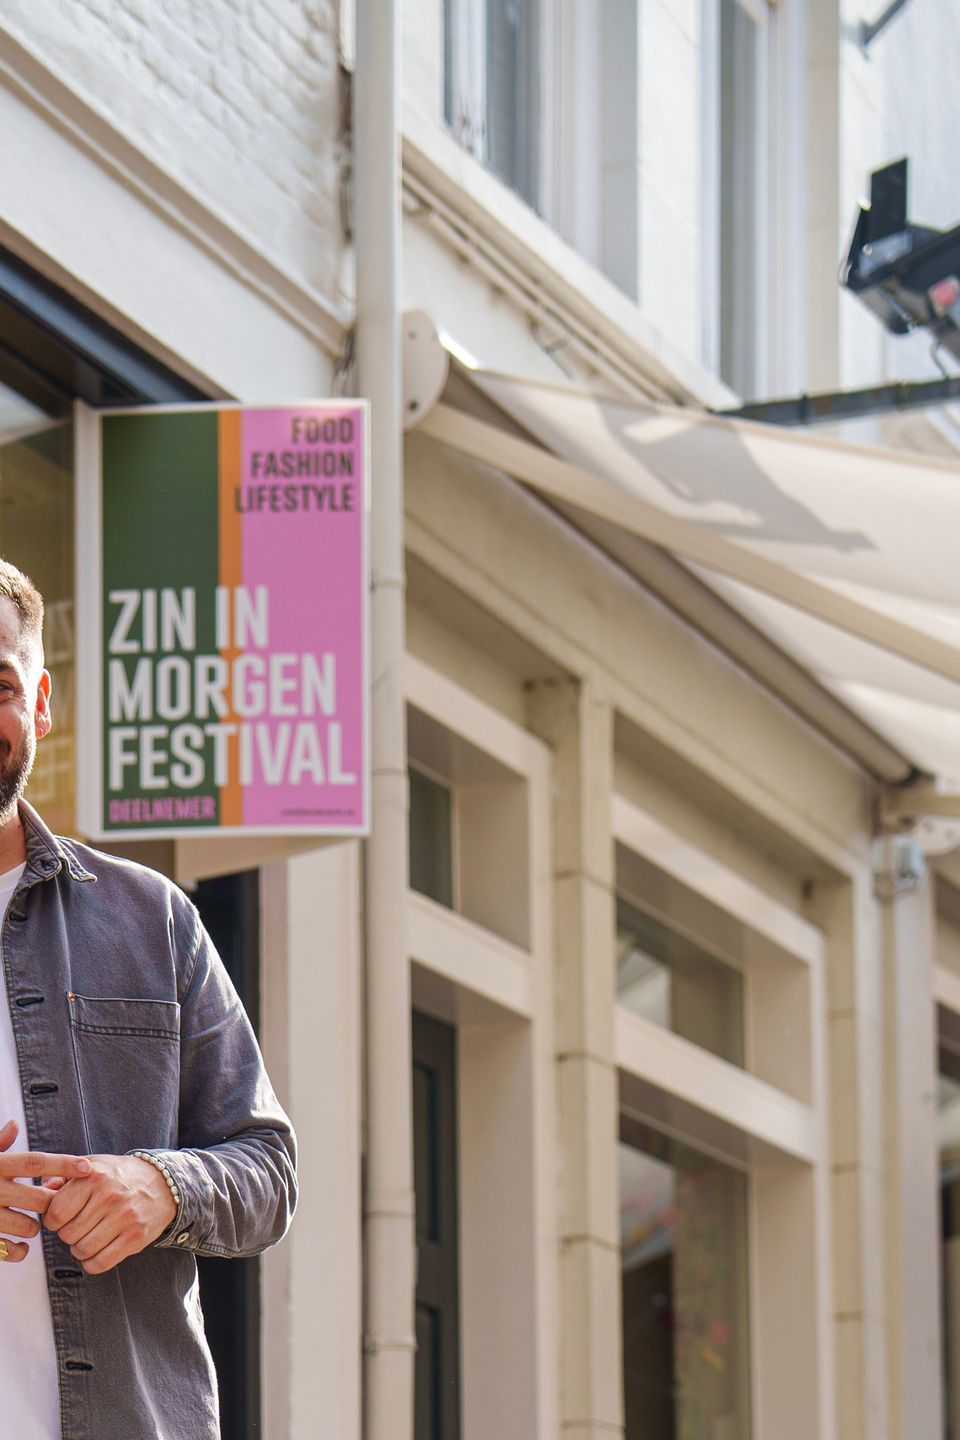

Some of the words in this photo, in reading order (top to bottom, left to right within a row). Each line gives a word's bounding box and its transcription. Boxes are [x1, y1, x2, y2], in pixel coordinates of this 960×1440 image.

[291, 416, 354, 445] FOOD
[251, 449, 354, 479] FASHION
[234, 483, 355, 513] LIFESTYLE
[108, 586, 196, 654] ZIN
[215, 584, 269, 650] IN
[108, 652, 337, 723] MORGEN
[109, 721, 357, 791] FESTIVAL
[109, 796, 215, 823] DEELNEMER
